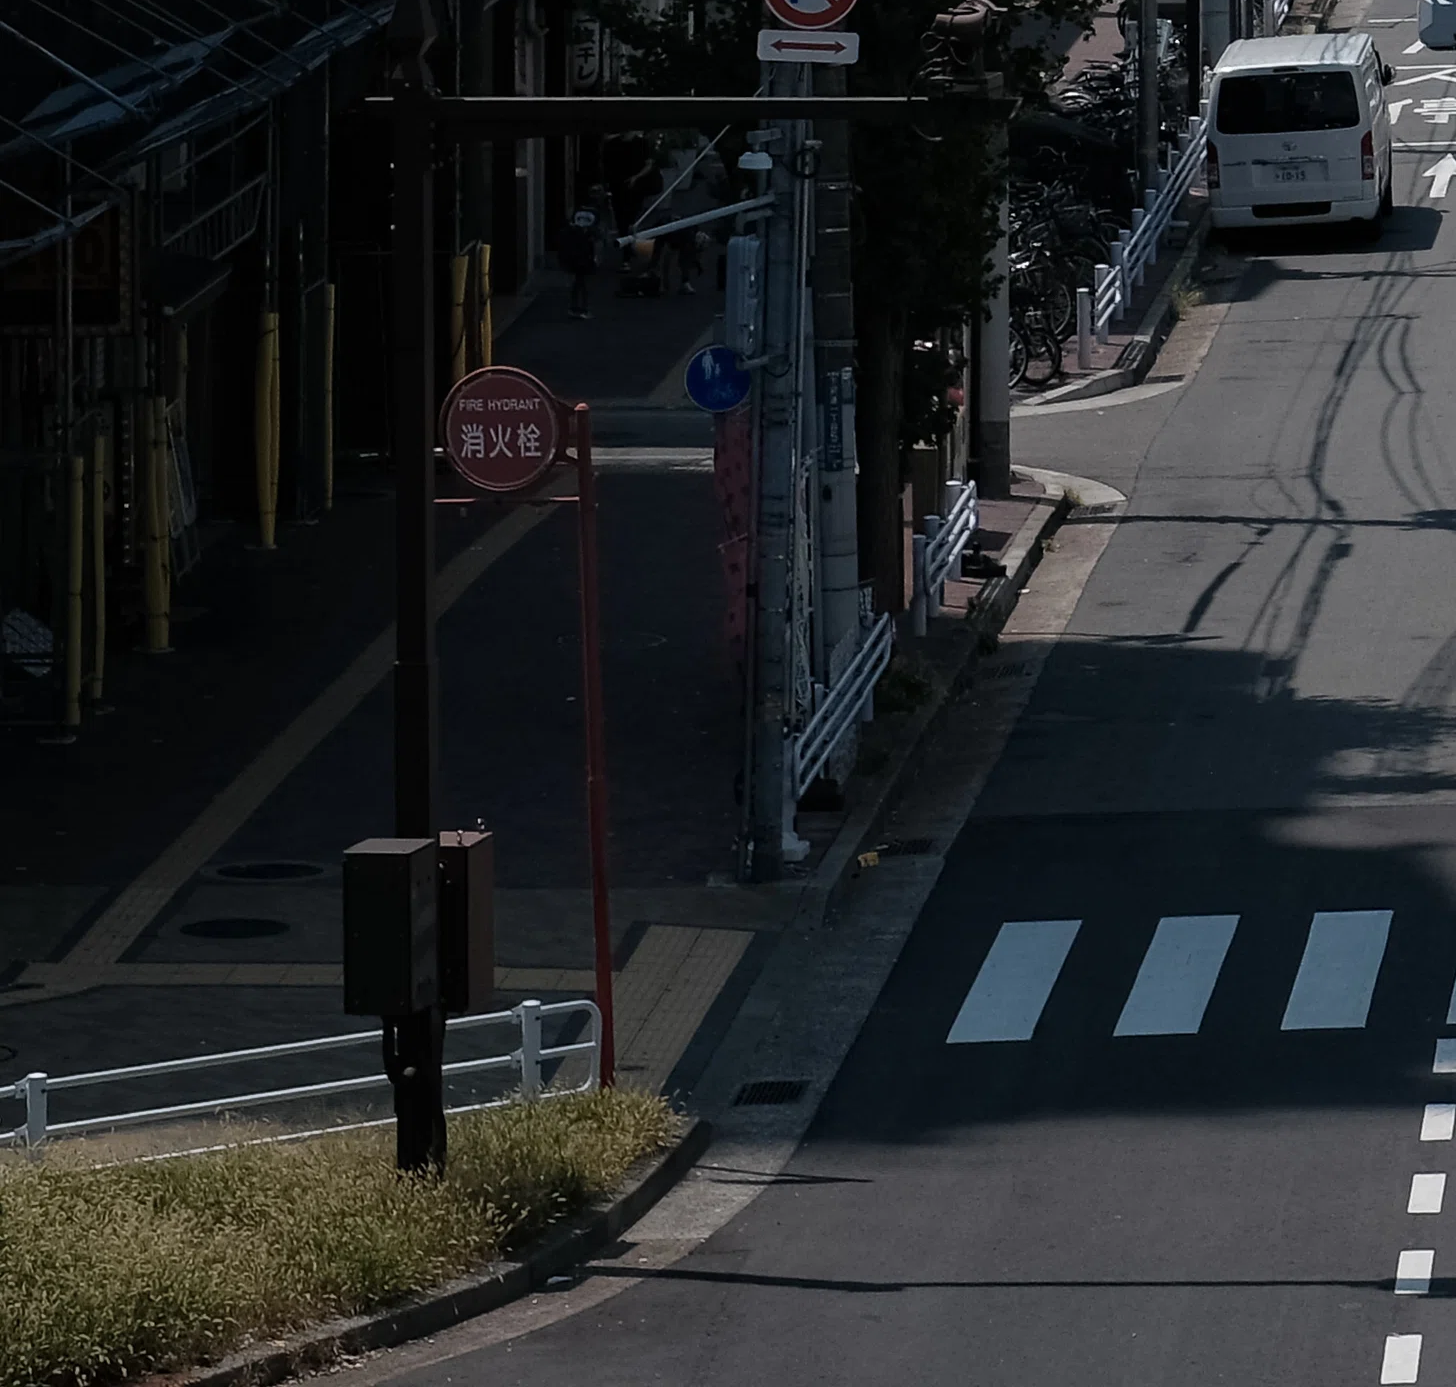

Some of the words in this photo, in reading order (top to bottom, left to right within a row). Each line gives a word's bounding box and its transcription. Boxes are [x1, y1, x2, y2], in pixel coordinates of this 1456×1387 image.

[459, 398, 484, 412] FIRE
[487, 397, 541, 412] HYDRANT
[460, 422, 543, 459] 消火栓
